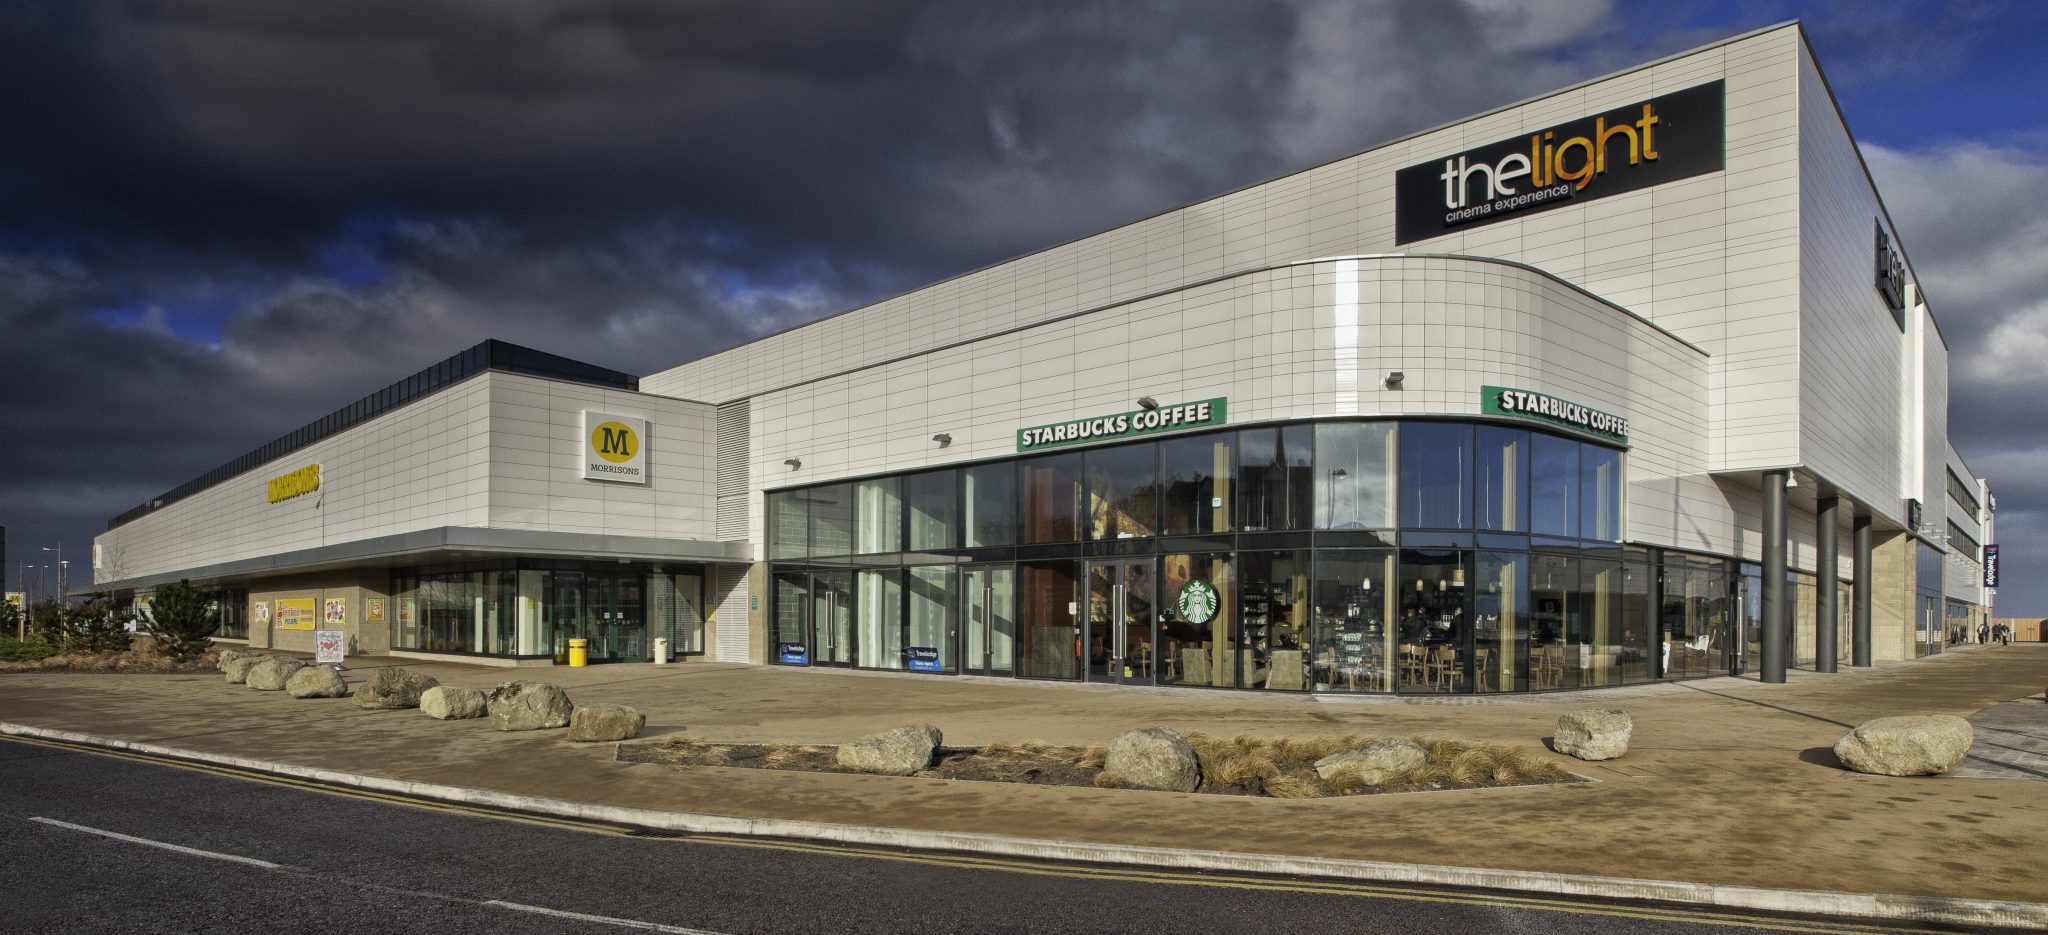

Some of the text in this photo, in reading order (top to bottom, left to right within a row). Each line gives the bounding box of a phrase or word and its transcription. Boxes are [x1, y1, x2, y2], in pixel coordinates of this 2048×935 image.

[1445, 185, 1568, 222] cinema experience
[1022, 402, 1210, 446] STARBUCKS COFFEE
[1502, 390, 1629, 437] STARBUCKS COFFEE
[601, 427, 629, 456] M
[591, 464, 639, 476] MORRISONS
